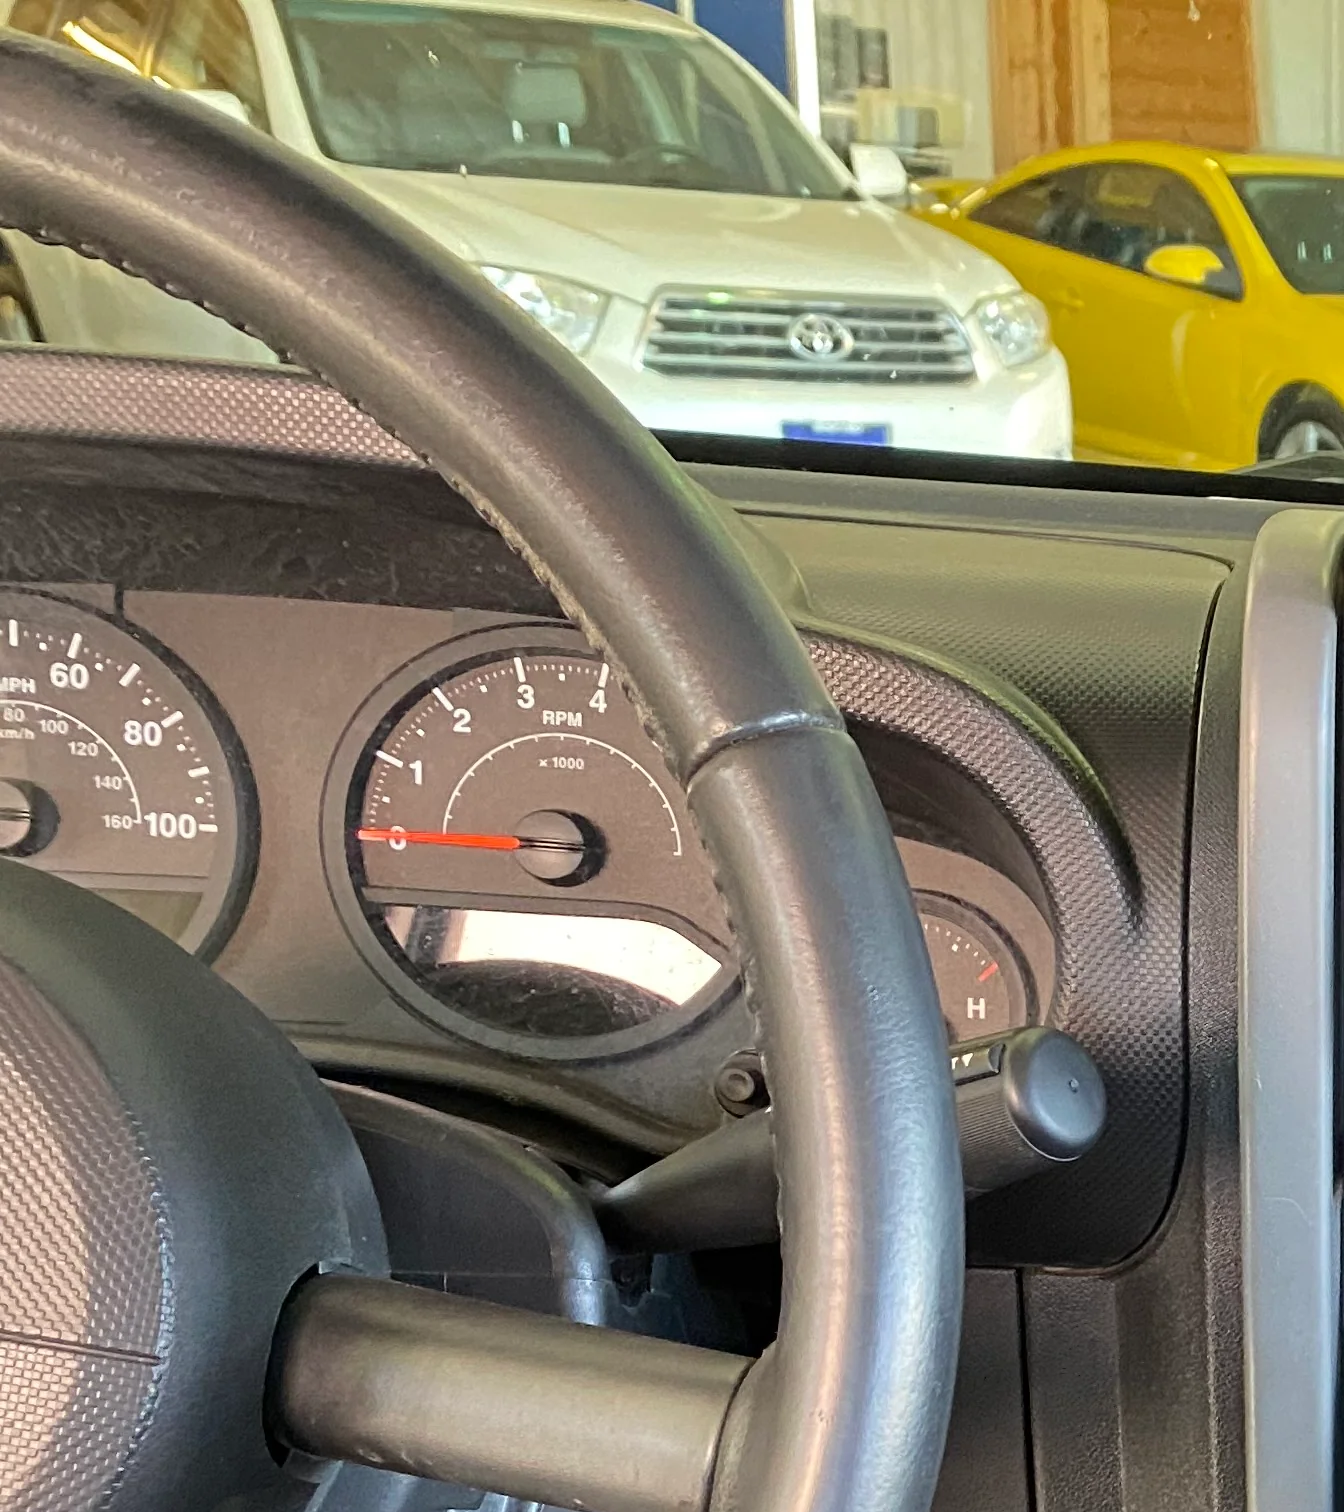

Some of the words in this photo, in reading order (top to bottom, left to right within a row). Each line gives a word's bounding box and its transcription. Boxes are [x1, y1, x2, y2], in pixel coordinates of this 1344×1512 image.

[50, 663, 89, 689] 60
[517, 685, 534, 708] 3
[589, 690, 607, 713] 4
[39, 719, 69, 735] 100
[451, 707, 471, 732] 2
[543, 710, 582, 727] RPM
[124, 719, 163, 746] 80
[68, 740, 99, 756] 120
[410, 760, 422, 784] 1
[552, 757, 584, 769] 1000
[95, 776, 123, 790] 140
[103, 815, 133, 829] 160
[144, 812, 198, 838] 100
[968, 998, 985, 1019] H
